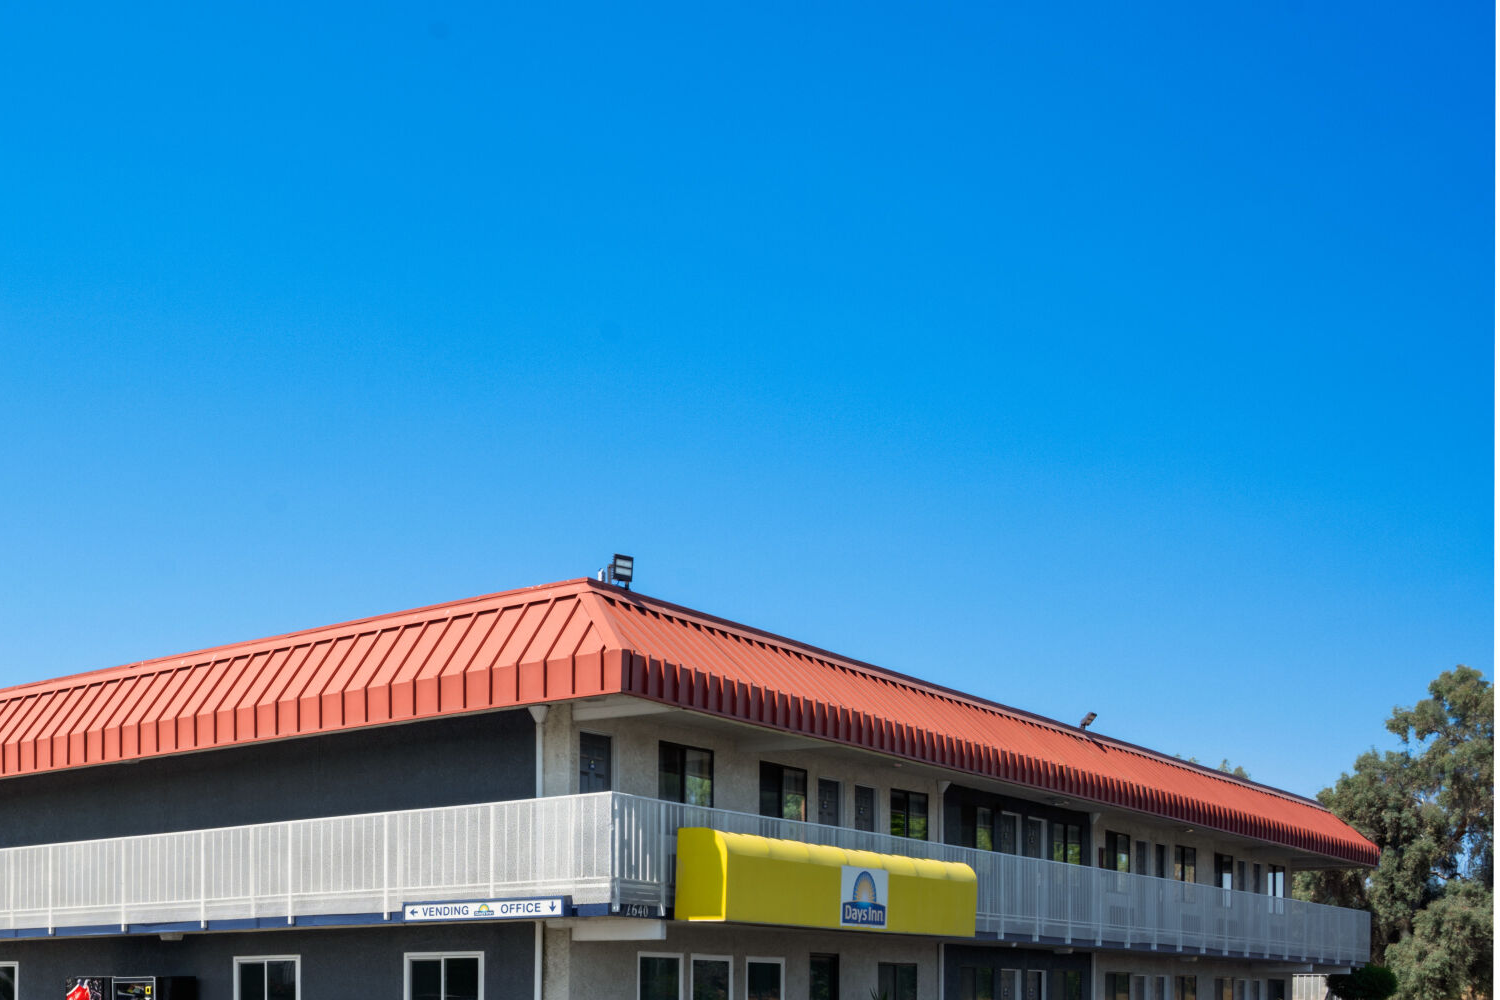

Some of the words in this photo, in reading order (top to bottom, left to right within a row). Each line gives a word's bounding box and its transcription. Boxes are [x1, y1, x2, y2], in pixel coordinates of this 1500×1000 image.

[422, 905, 469, 917] VENDING
[500, 902, 541, 914] OFFICE
[845, 904, 867, 922] Days
[868, 907, 884, 921] Inn
